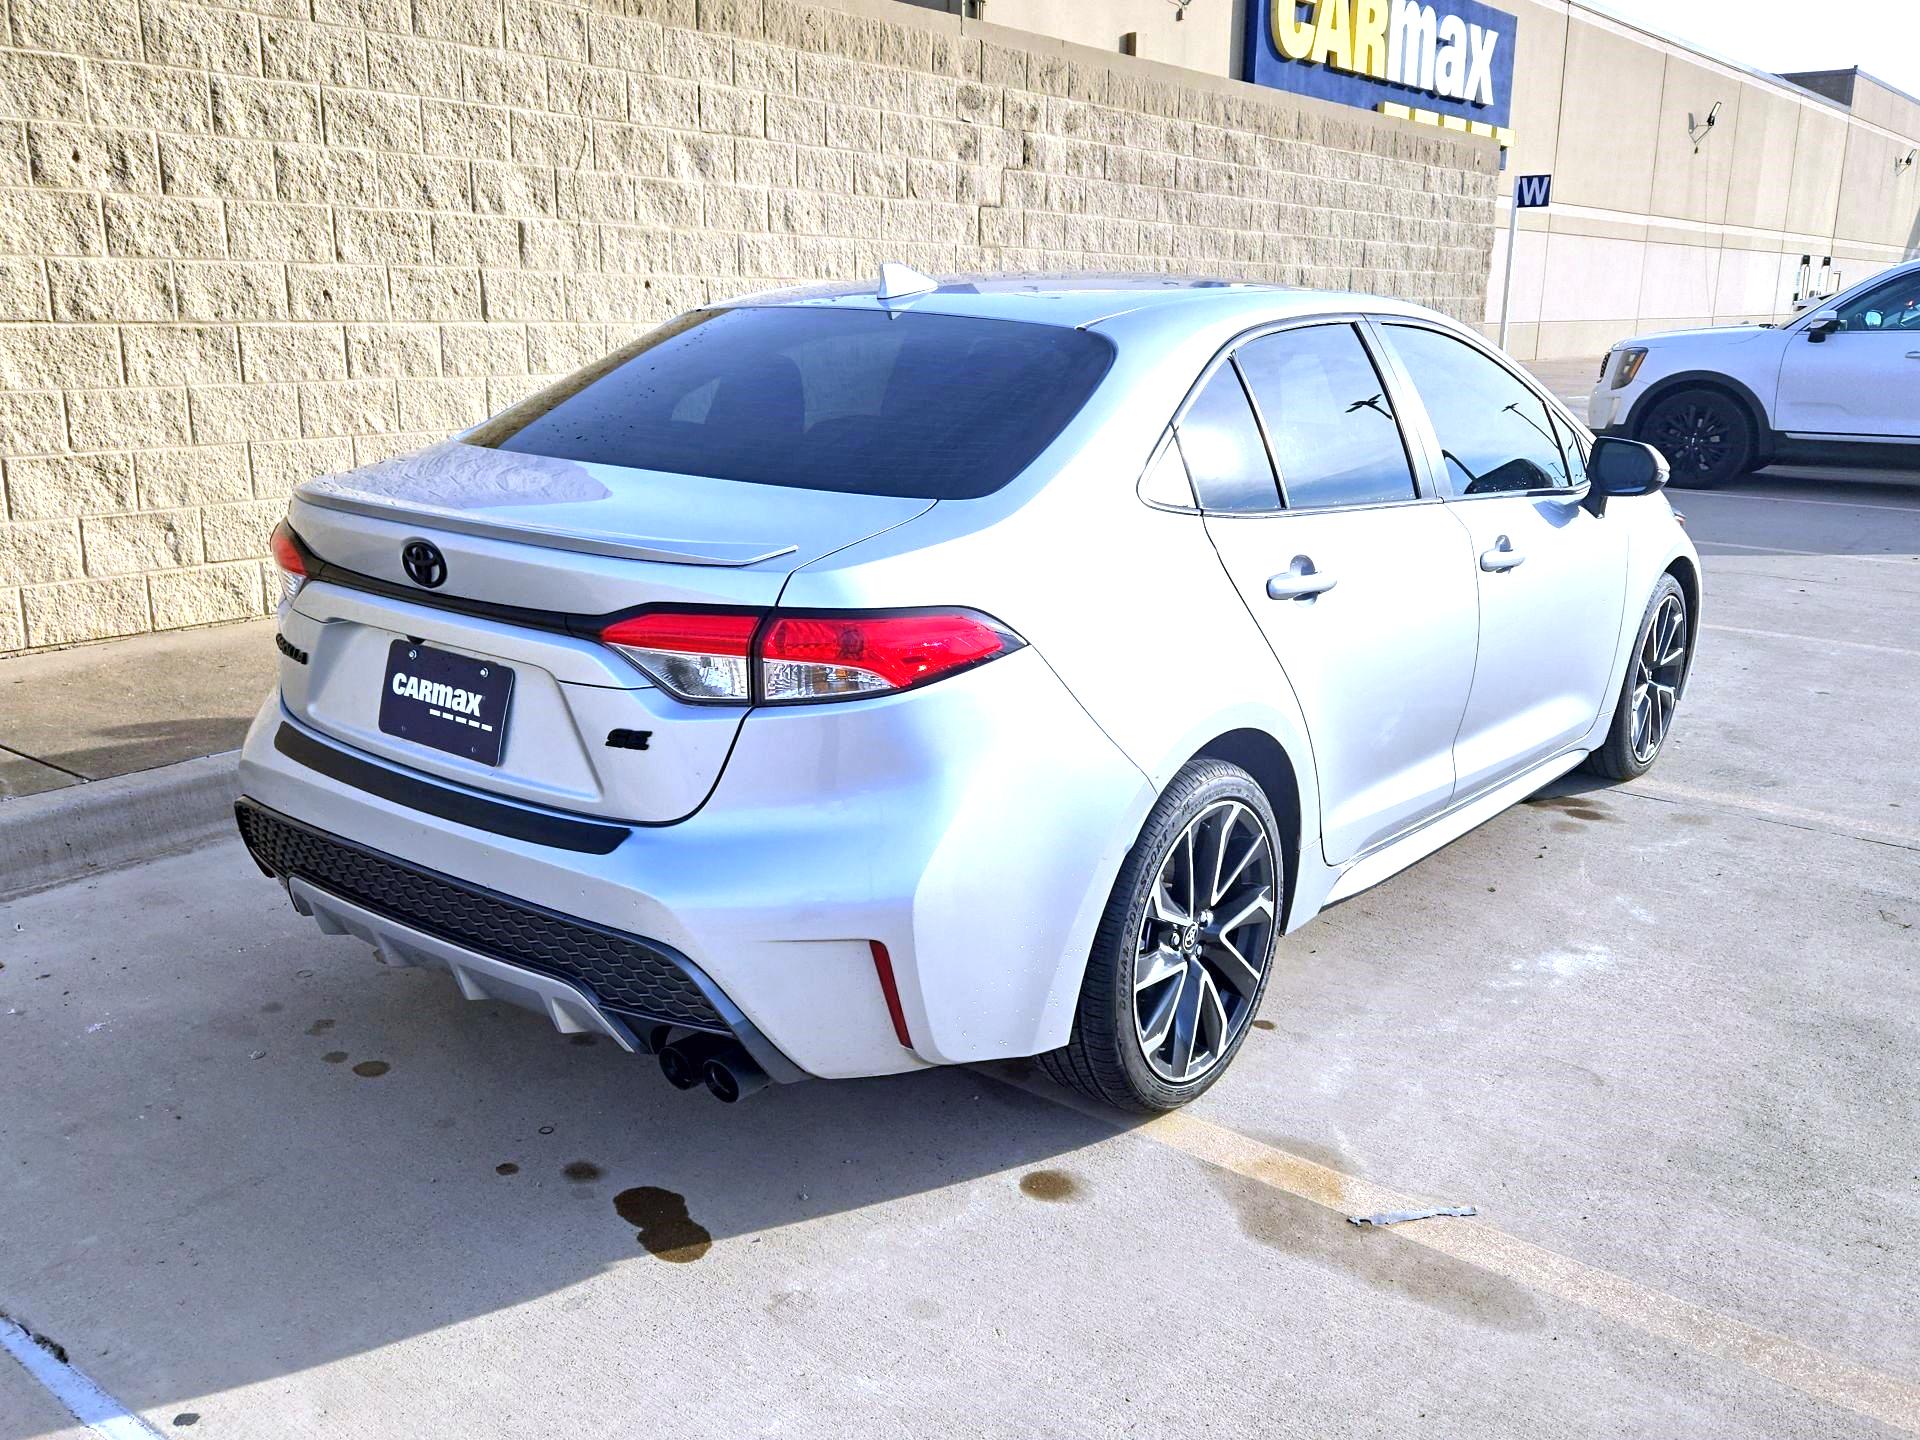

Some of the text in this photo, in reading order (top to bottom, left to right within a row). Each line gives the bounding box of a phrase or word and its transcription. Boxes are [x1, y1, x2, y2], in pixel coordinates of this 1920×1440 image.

[1274, 0, 1499, 106] CARmax
[1521, 177, 1549, 205] W
[392, 672, 483, 717] CARmax
